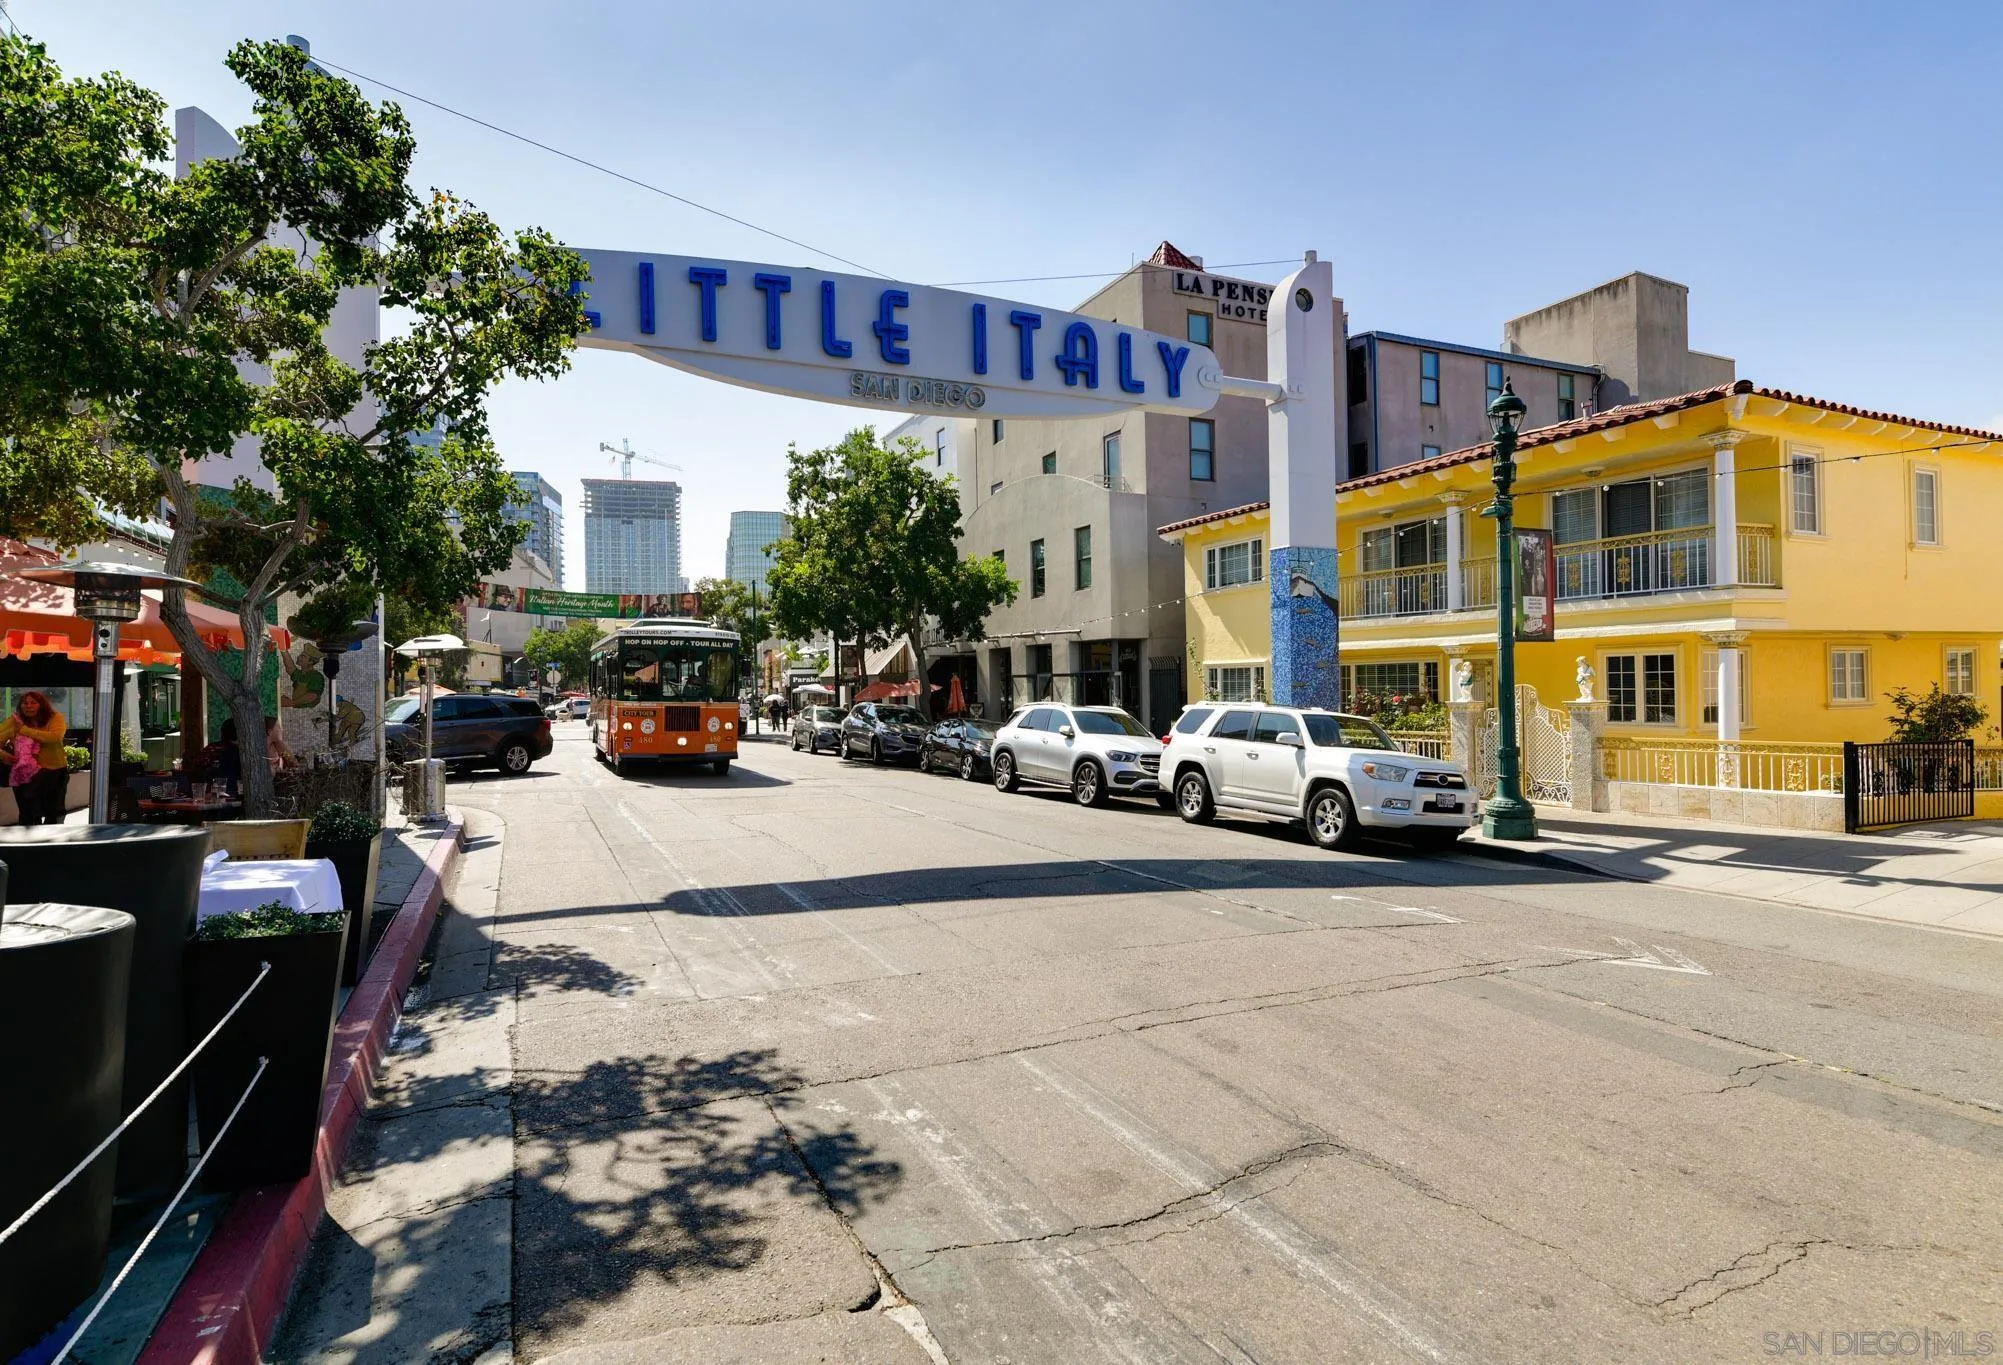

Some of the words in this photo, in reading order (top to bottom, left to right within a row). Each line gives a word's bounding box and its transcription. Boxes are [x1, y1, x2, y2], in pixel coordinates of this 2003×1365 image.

[1176, 272, 1204, 294] LA
[972, 303, 1190, 398] ITALY
[851, 372, 899, 401] SAN
[907, 380, 986, 410] DIEGO
[557, 597, 587, 609] Heritage
[588, 599, 614, 609] Month
